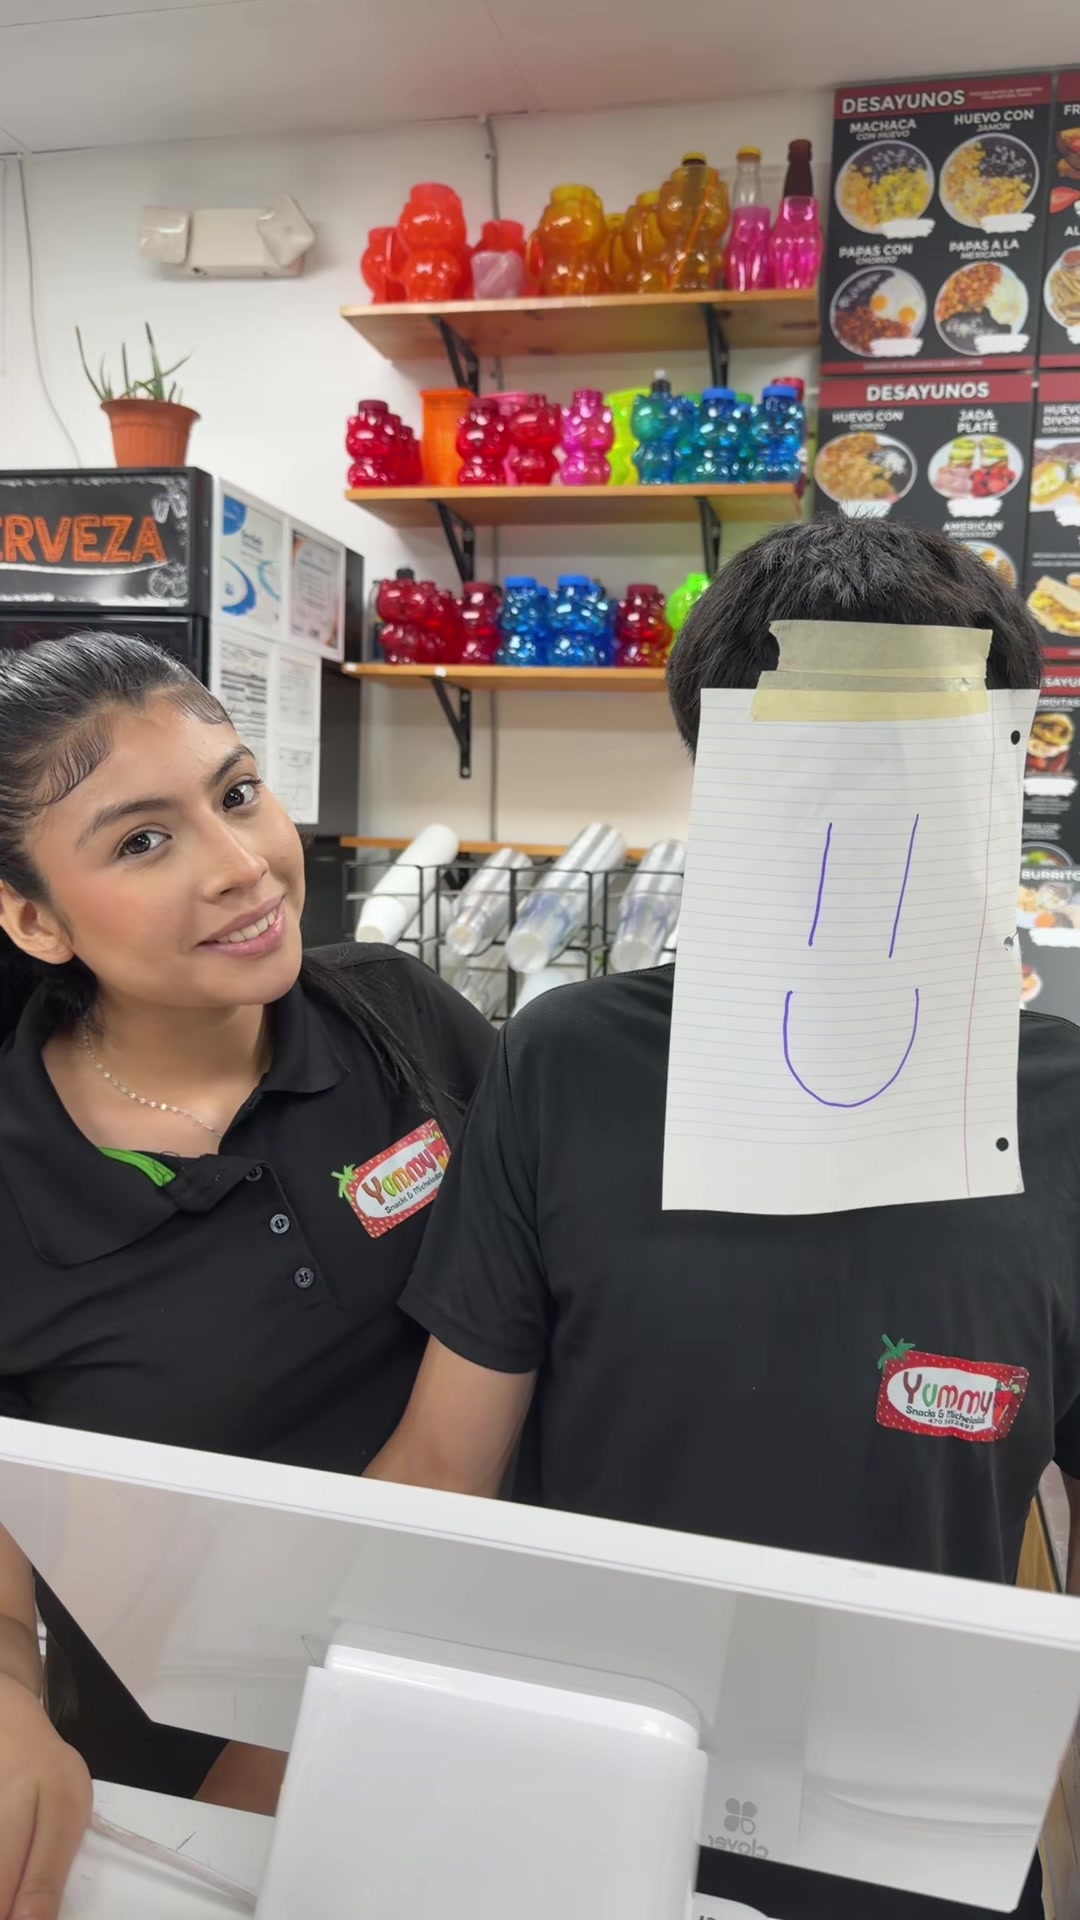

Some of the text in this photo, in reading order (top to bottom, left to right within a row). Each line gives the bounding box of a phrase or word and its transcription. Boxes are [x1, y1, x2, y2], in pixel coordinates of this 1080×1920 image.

[841, 89, 966, 114] DESAYUNOS
[849, 117, 918, 134] MACHACA
[953, 109, 1035, 126] HUEVO CON
[856, 130, 911, 141] CON HUEVO
[838, 243, 914, 259] PAPAS CON
[949, 238, 1020, 253] PAPAS A LA
[866, 381, 990, 402] DESAYUNOS
[832, 409, 905, 424] HUEVO CON
[959, 409, 996, 421] JADA
[957, 421, 998, 433] PLATE
[942, 521, 1004, 532] AMERICAN
[0, 513, 168, 563] RVEZA
[361, 1149, 438, 1206] Yummy
[385, 1196, 409, 1214] Snacks
[903, 1371, 993, 1417] Yummy
[906, 1405, 936, 1418] Snacks
[937, 1409, 945, 1419] &
